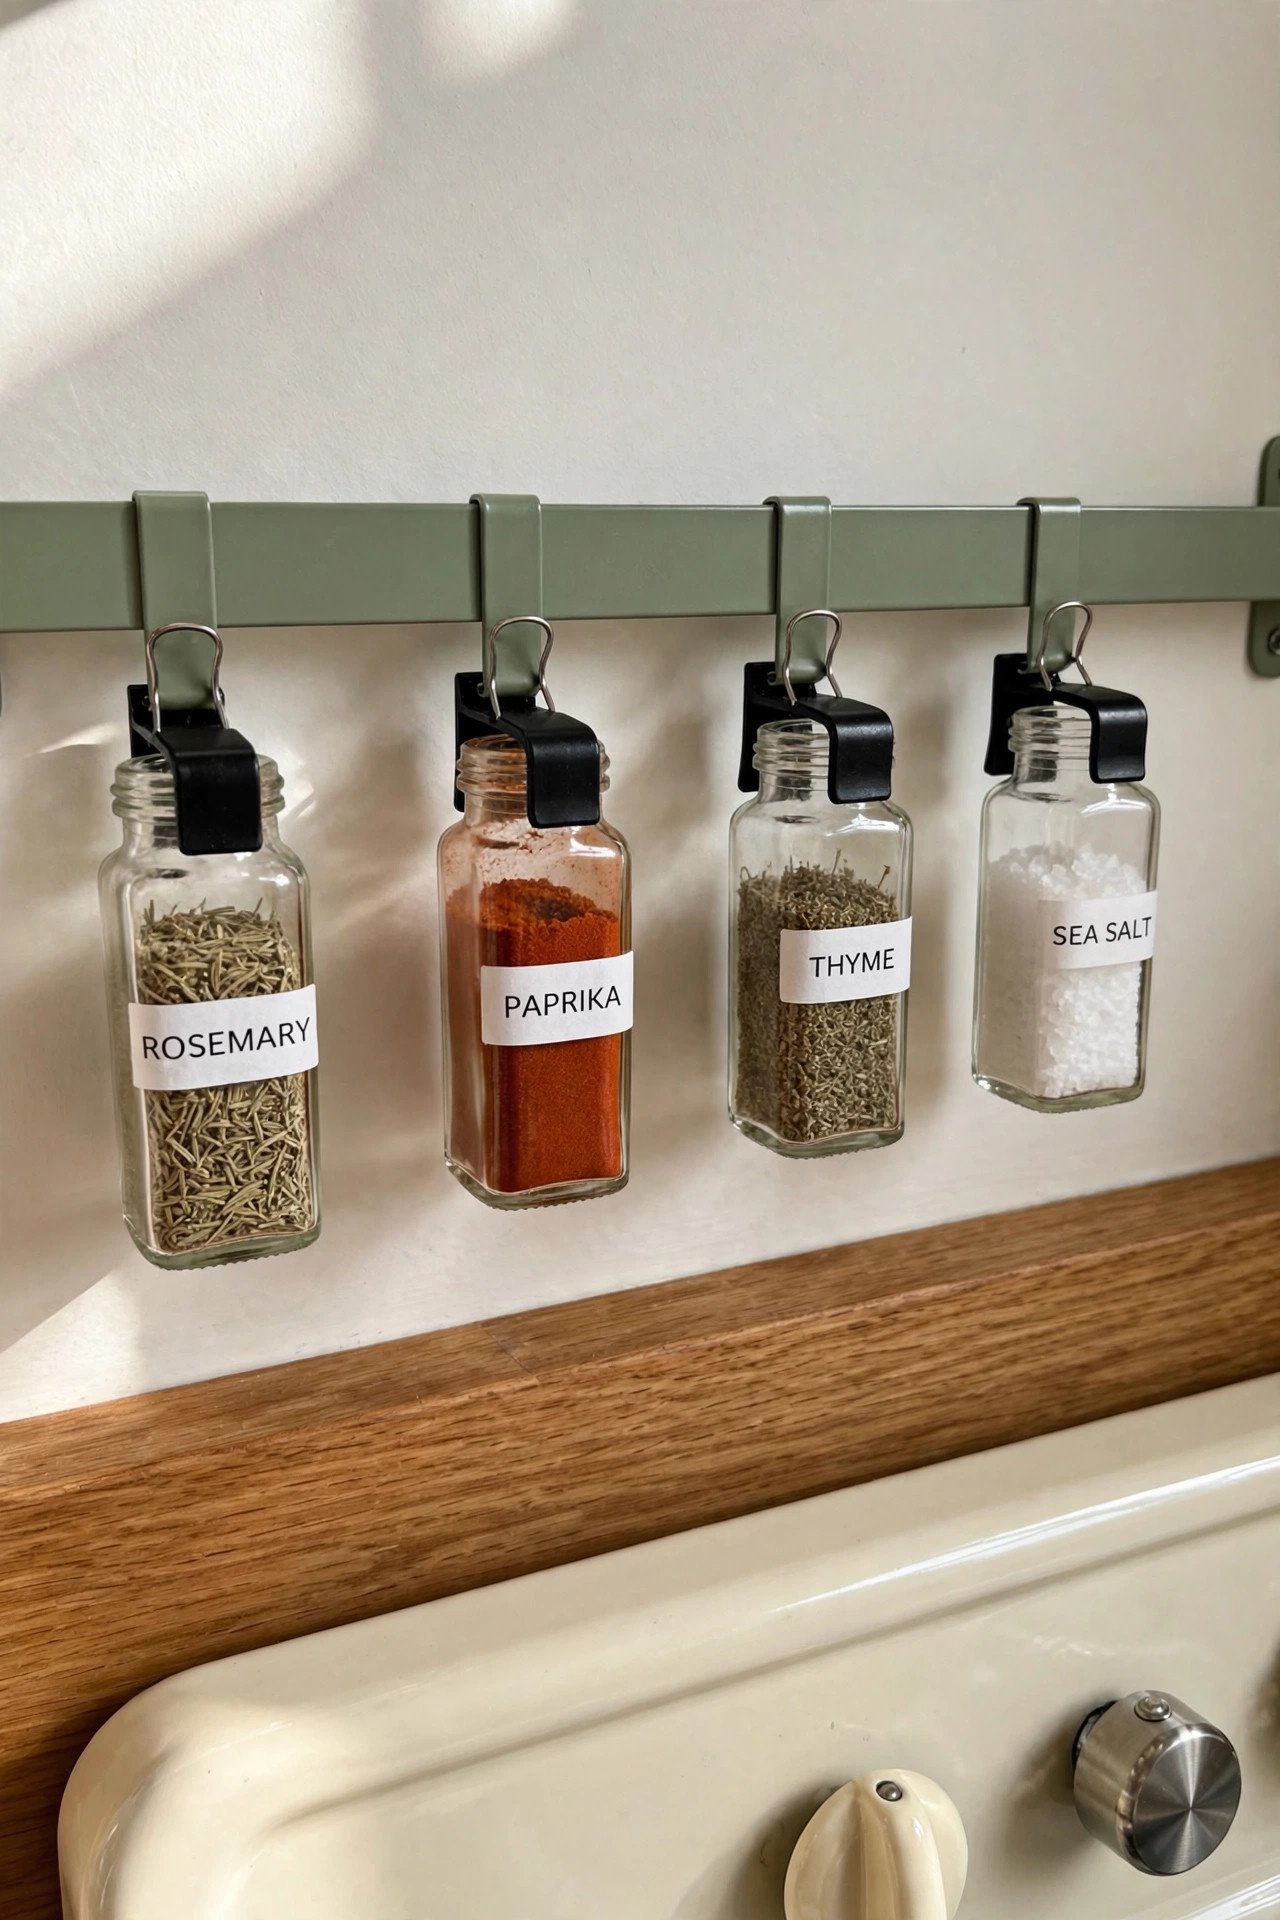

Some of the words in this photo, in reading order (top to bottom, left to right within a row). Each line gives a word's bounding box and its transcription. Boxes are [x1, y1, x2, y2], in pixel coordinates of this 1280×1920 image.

[1052, 924, 1099, 946] SEA
[1105, 916, 1152, 942] SALT
[809, 947, 896, 979] THYME
[504, 985, 622, 1019] PAPRIKA
[141, 1016, 311, 1061] ROSEMARY
